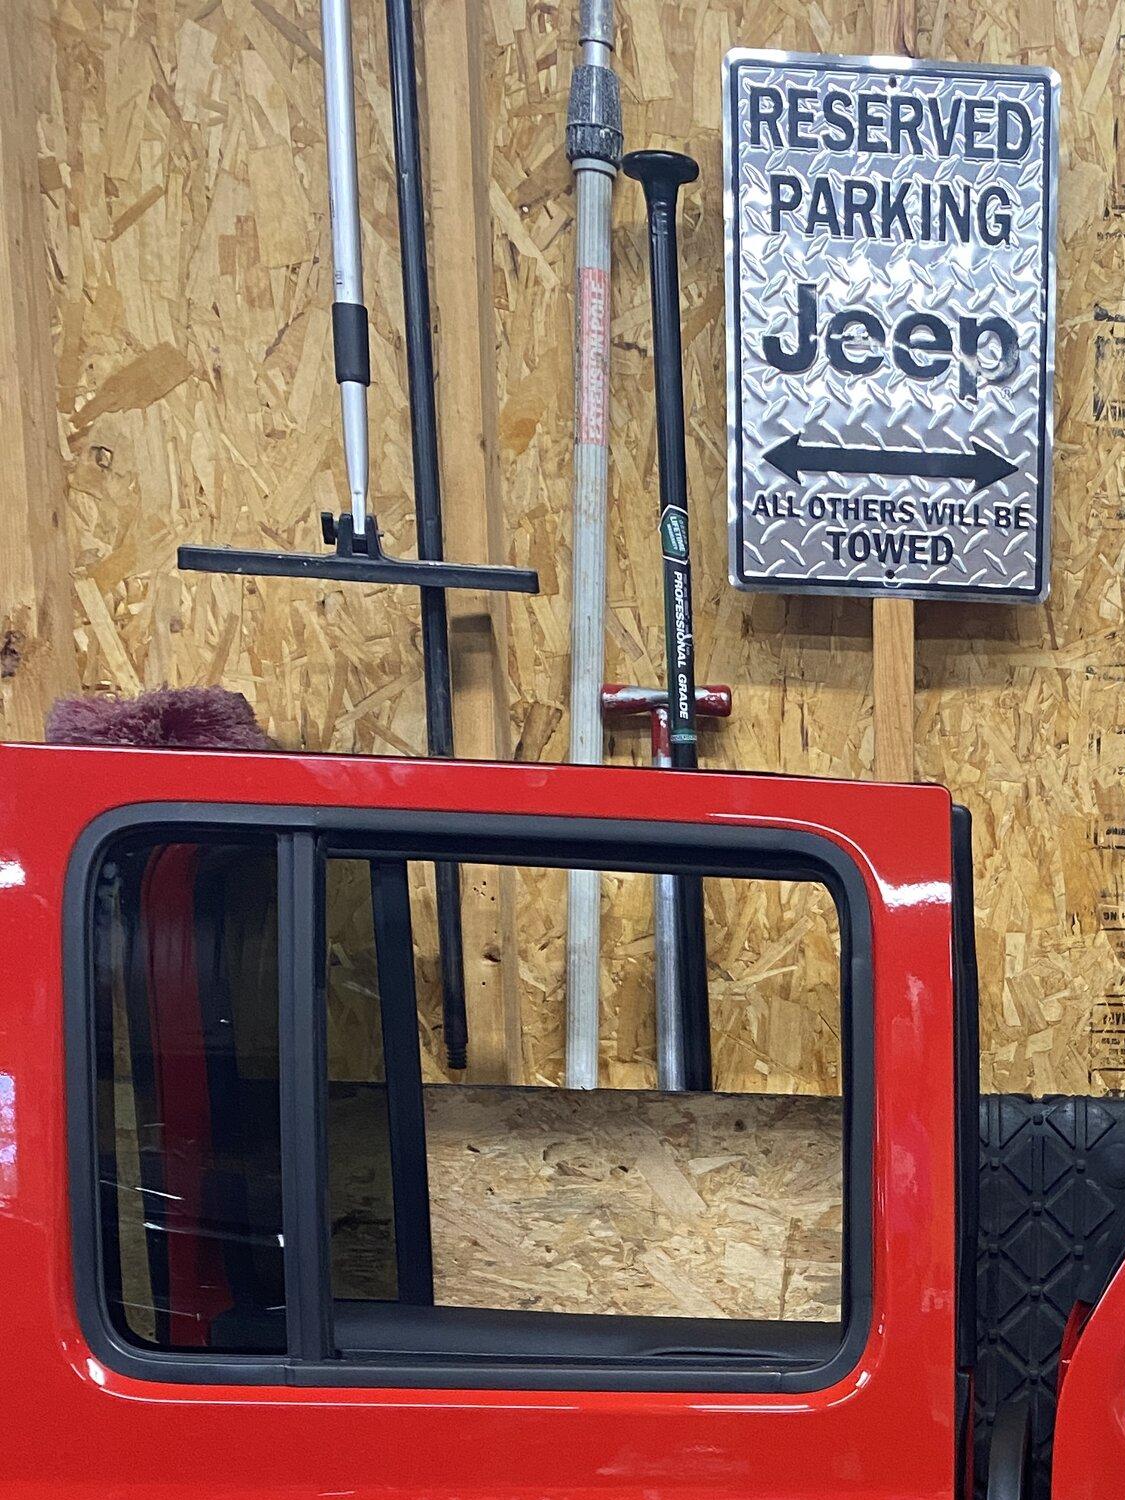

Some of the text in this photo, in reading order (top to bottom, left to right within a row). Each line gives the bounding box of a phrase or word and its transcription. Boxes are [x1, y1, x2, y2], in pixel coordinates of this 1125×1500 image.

[750, 86, 1032, 161] RESERVED
[770, 174, 1013, 246] PARKING
[589, 281, 605, 331] POLE
[762, 283, 1020, 402] Jeep
[669, 516, 686, 552] LIFETIME
[752, 494, 1030, 529] ALL OTHERS WILL BE
[826, 531, 954, 565] TOWED
[673, 571, 687, 668] PROFESSIONAL
[678, 673, 689, 720] GRADE
